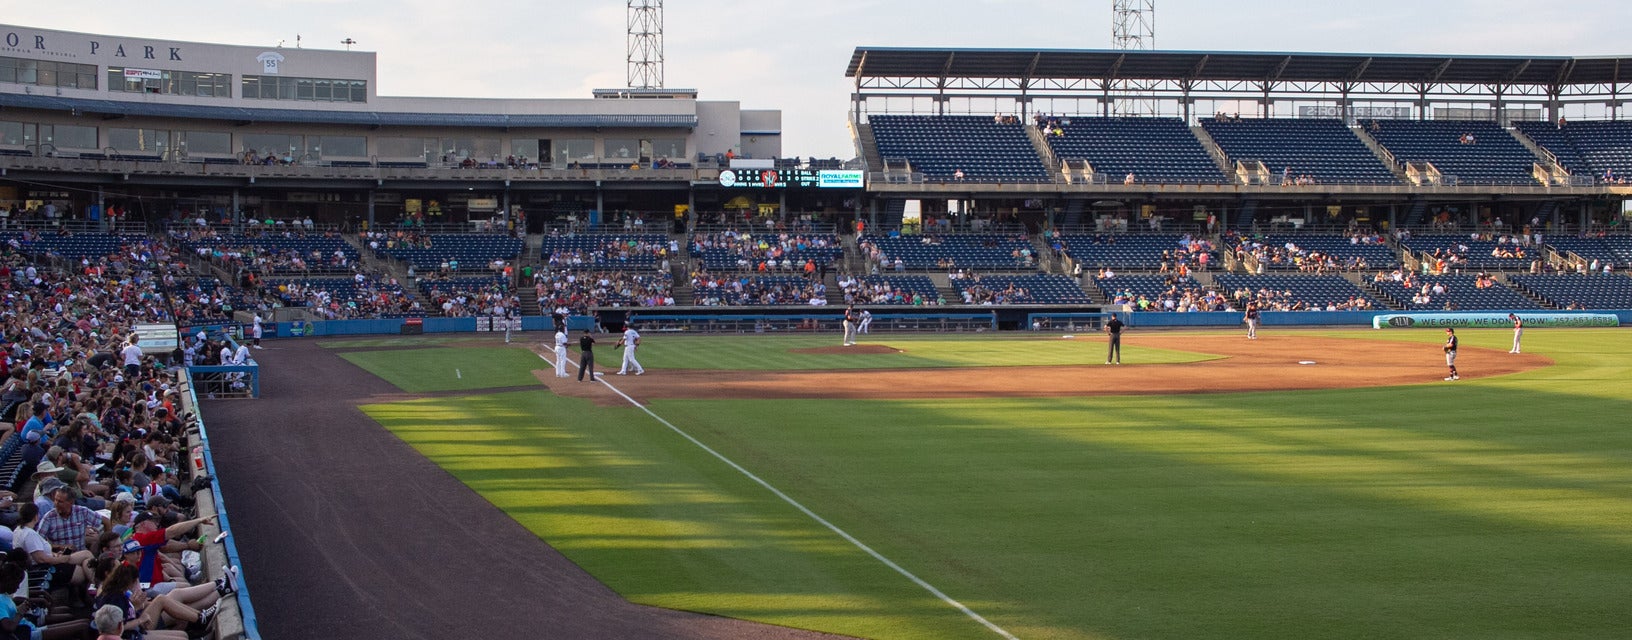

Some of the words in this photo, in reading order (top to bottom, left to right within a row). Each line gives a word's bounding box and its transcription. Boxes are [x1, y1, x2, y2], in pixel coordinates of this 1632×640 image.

[90, 41, 182, 61] PARK
[1395, 316, 1409, 326] ALM
[1421, 318, 1436, 326] WE
[1440, 318, 1470, 326] GROW,
